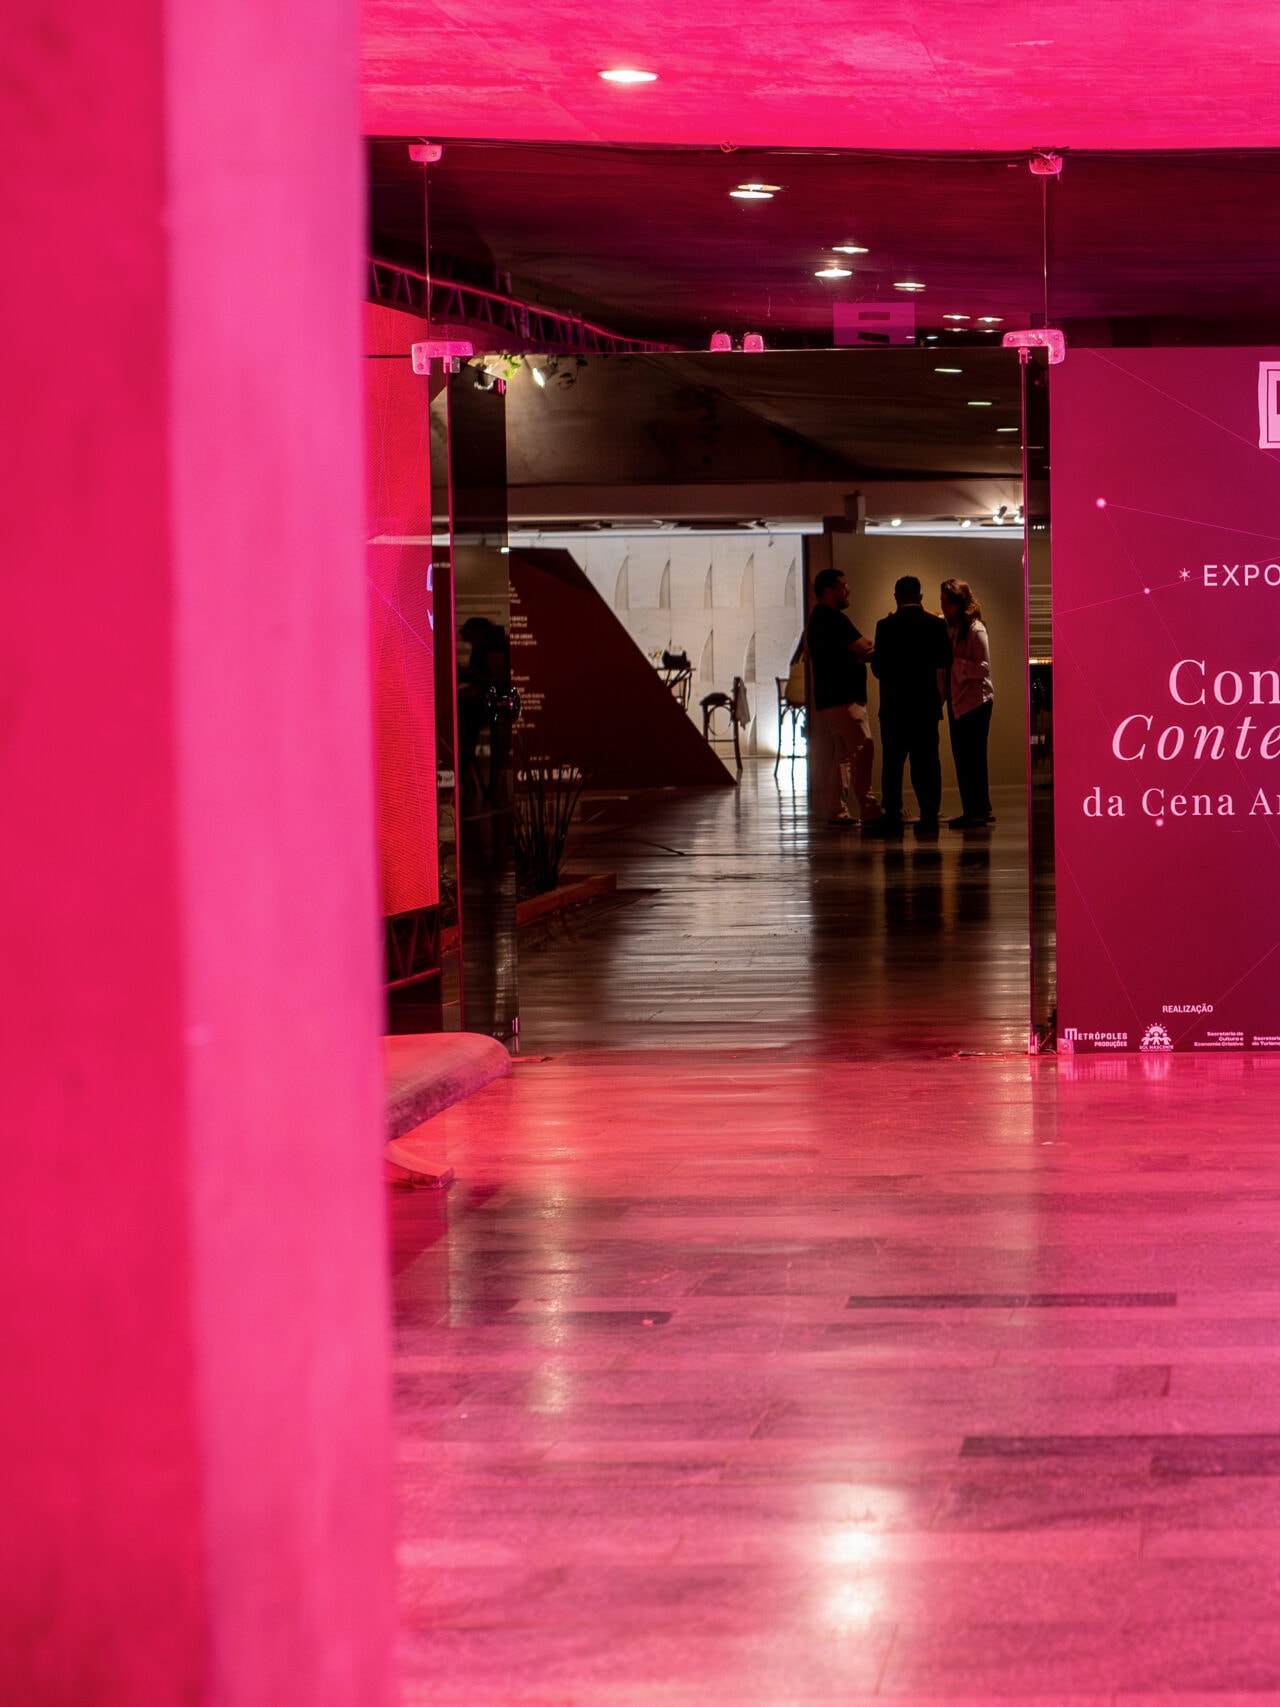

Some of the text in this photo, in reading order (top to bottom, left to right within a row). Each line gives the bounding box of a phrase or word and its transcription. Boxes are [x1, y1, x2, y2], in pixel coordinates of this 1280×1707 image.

[1082, 786, 1126, 817] da
[1141, 787, 1236, 816] Cena
[1162, 1004, 1214, 1014] REALIZAÇÃO
[1064, 1028, 1128, 1040] METRÓPOLES
[1094, 1040, 1128, 1048] PRODUÇÕES
